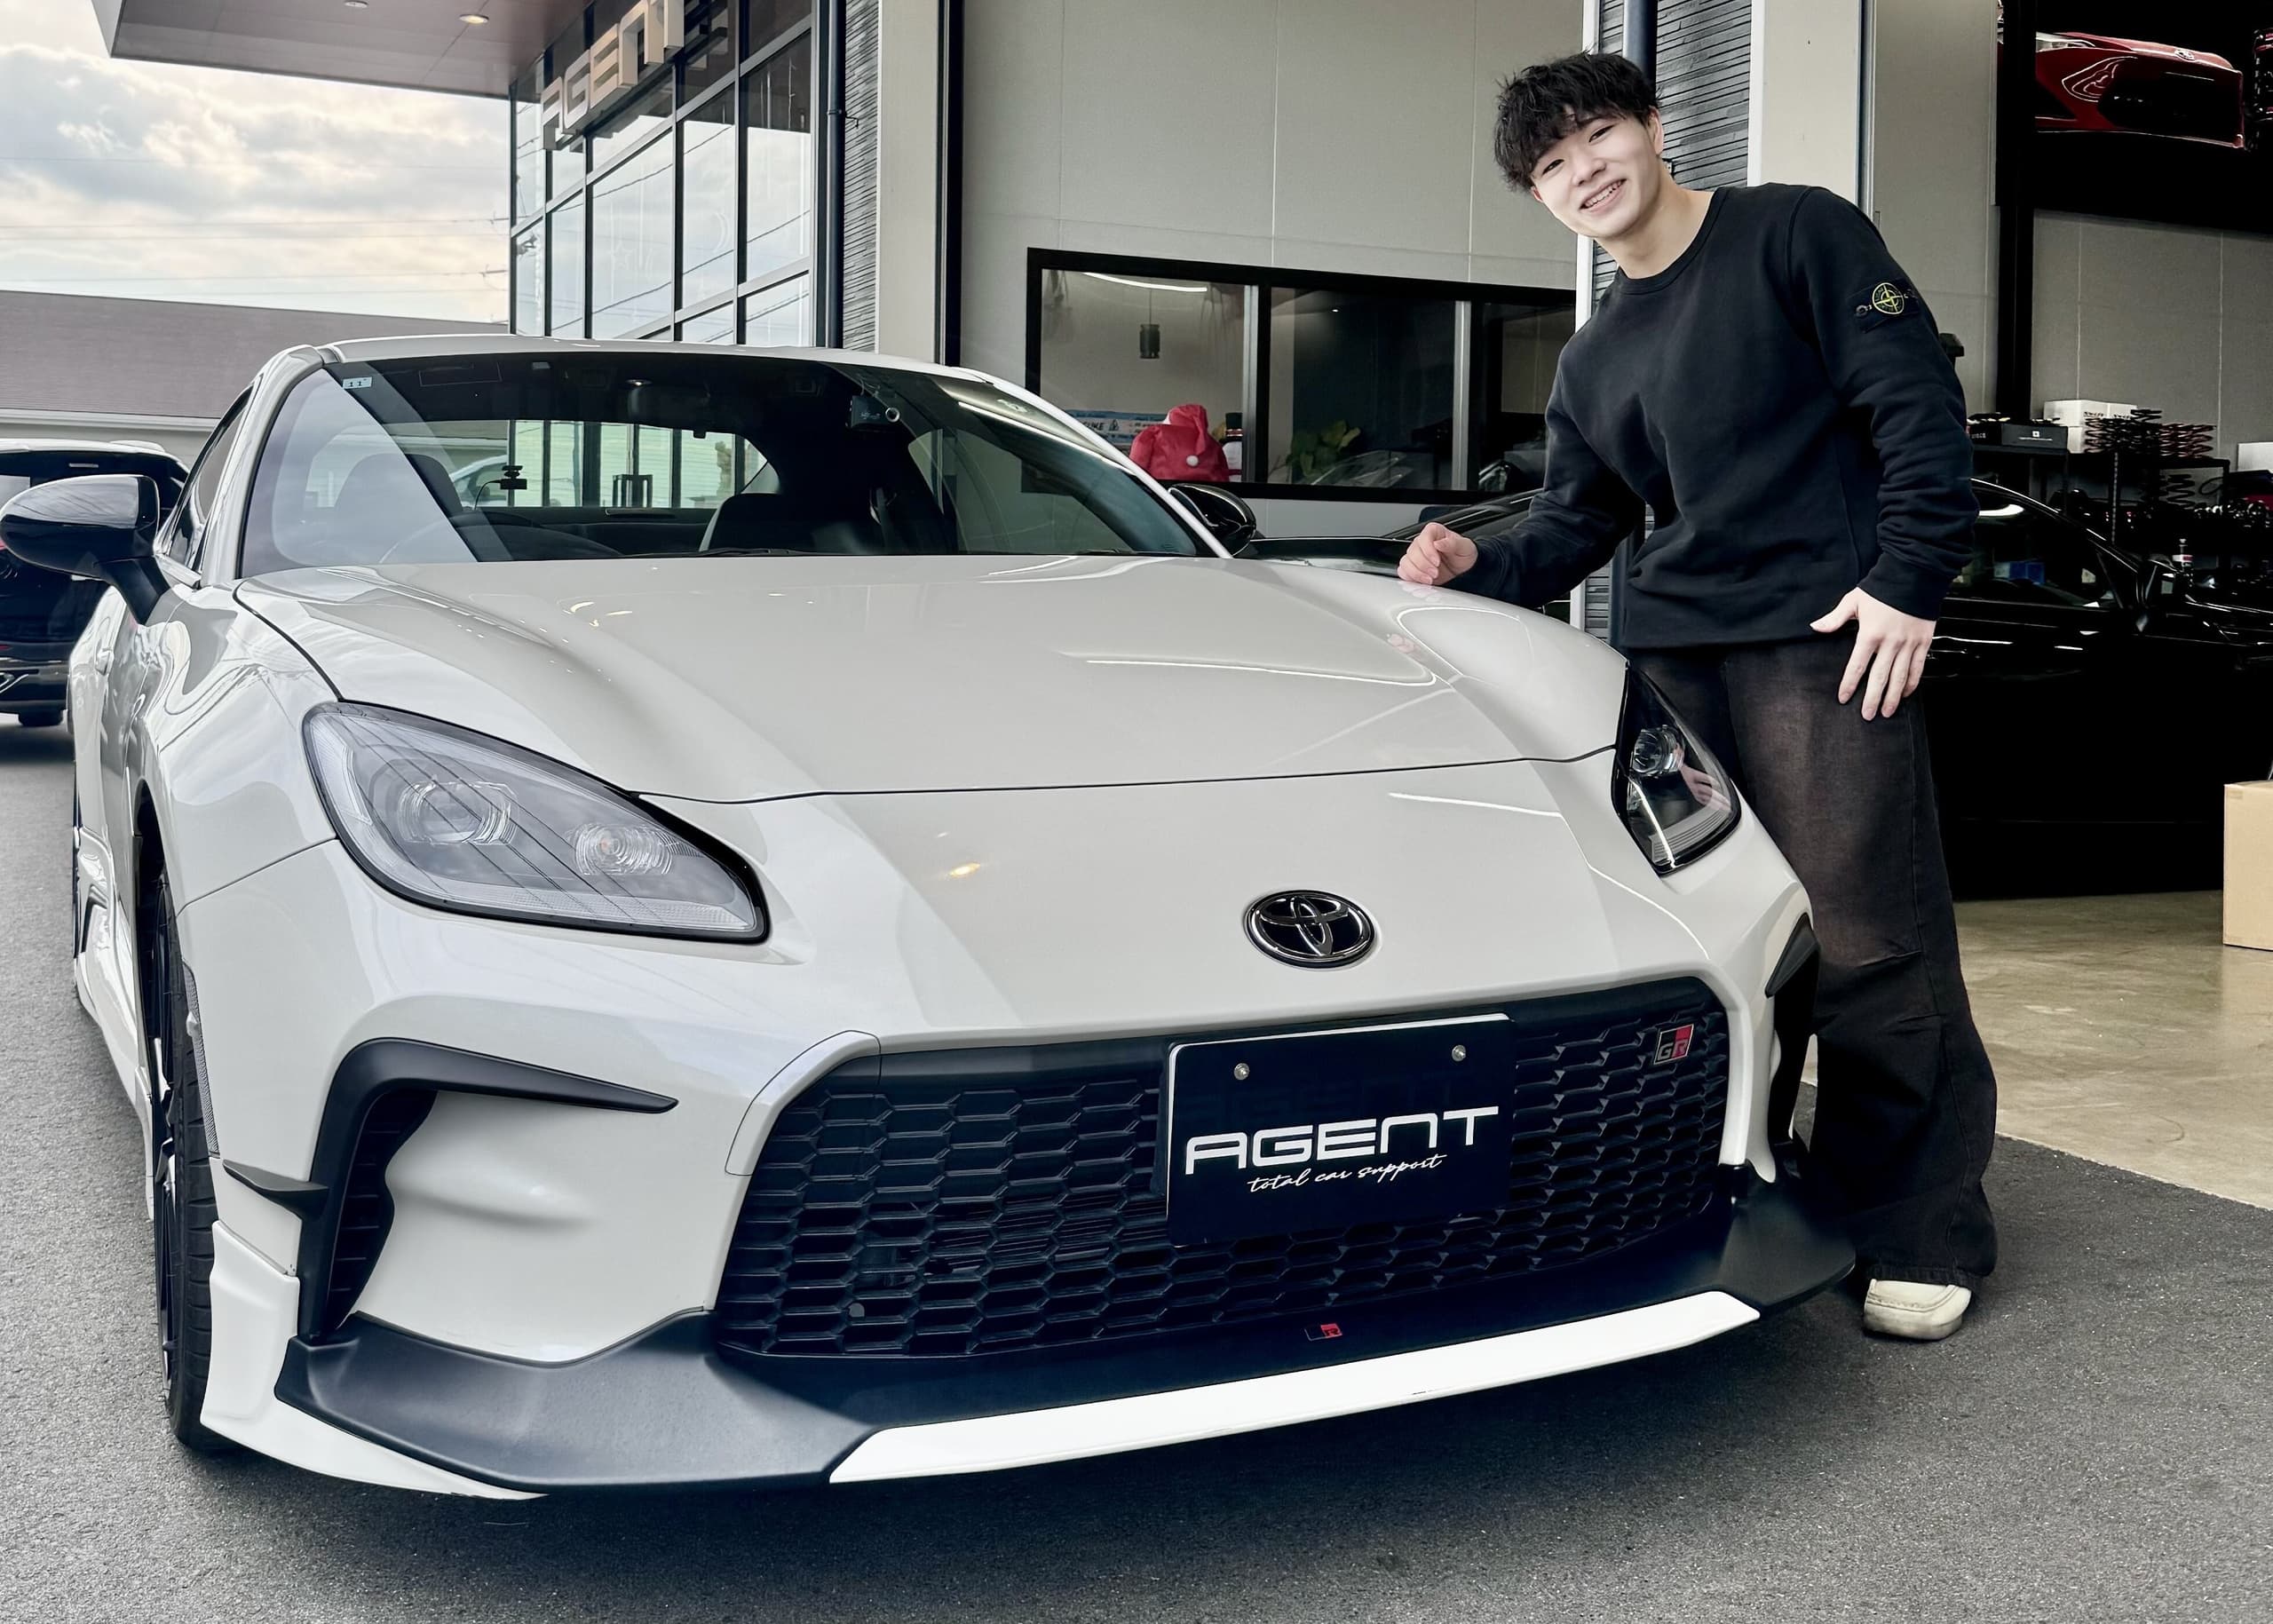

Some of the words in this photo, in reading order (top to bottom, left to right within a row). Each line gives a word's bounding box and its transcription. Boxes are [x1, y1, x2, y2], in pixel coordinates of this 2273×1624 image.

[1185, 1105, 1499, 1176] AGENT
[1247, 1167, 1312, 1193] total
[1314, 1170, 1353, 1183] car
[1357, 1153, 1448, 1184] support
